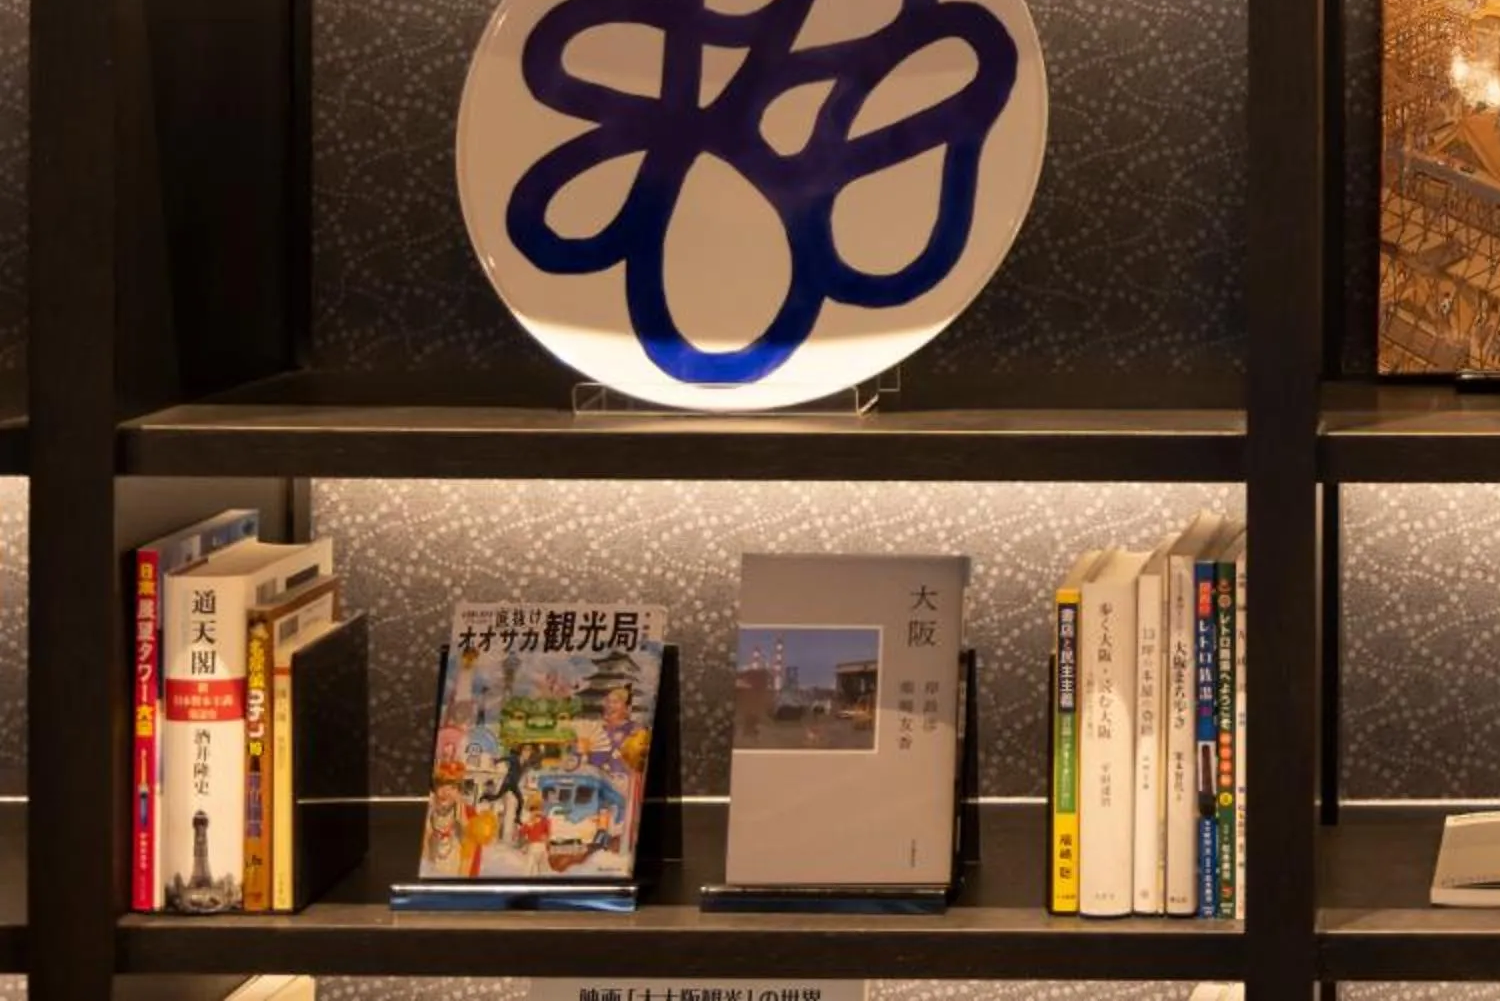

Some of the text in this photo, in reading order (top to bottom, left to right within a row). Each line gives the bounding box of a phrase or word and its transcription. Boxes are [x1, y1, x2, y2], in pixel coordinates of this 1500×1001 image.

[192, 589, 216, 675] 通天閣
[544, 610, 641, 653] 観光局
[908, 585, 938, 647] 大阪
